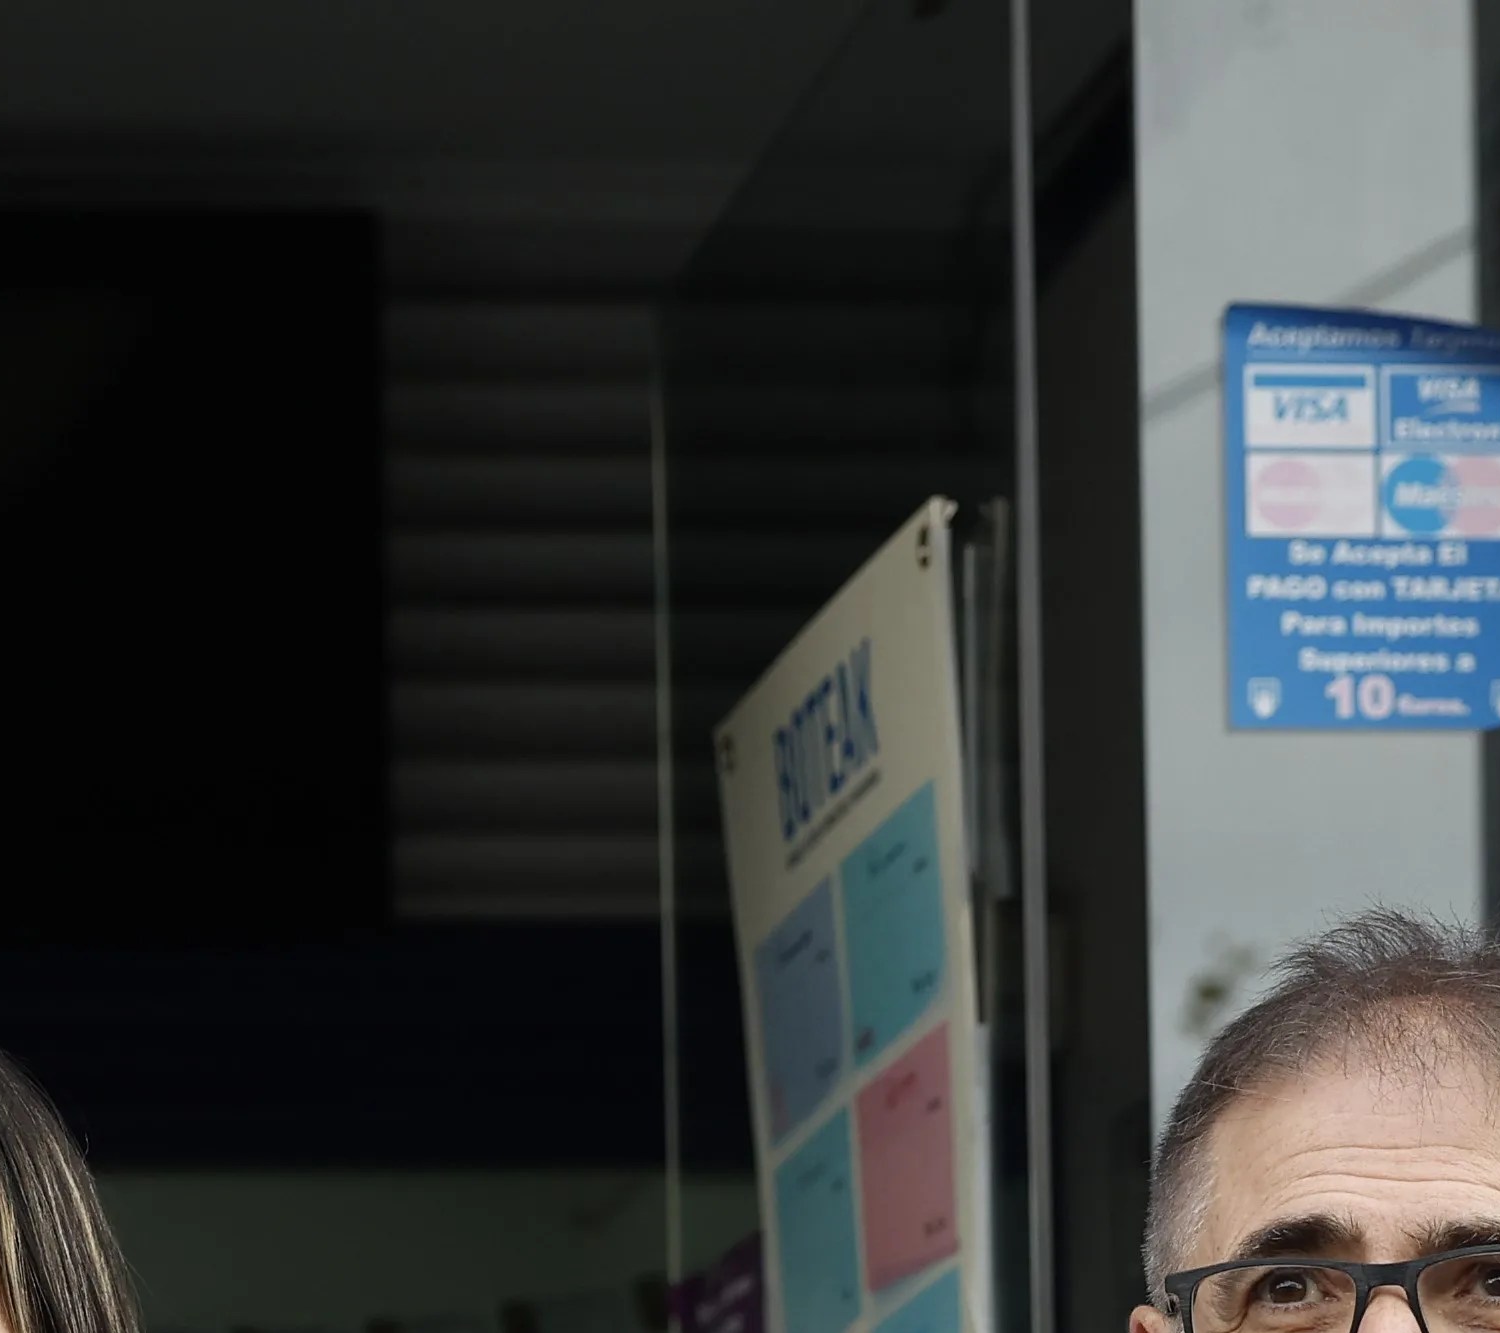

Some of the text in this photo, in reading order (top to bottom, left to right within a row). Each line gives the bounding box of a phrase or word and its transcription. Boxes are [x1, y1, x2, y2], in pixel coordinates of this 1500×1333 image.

[1272, 396, 1348, 421] VISA
[1281, 611, 1347, 636] Para
[1324, 673, 1395, 720] 10
